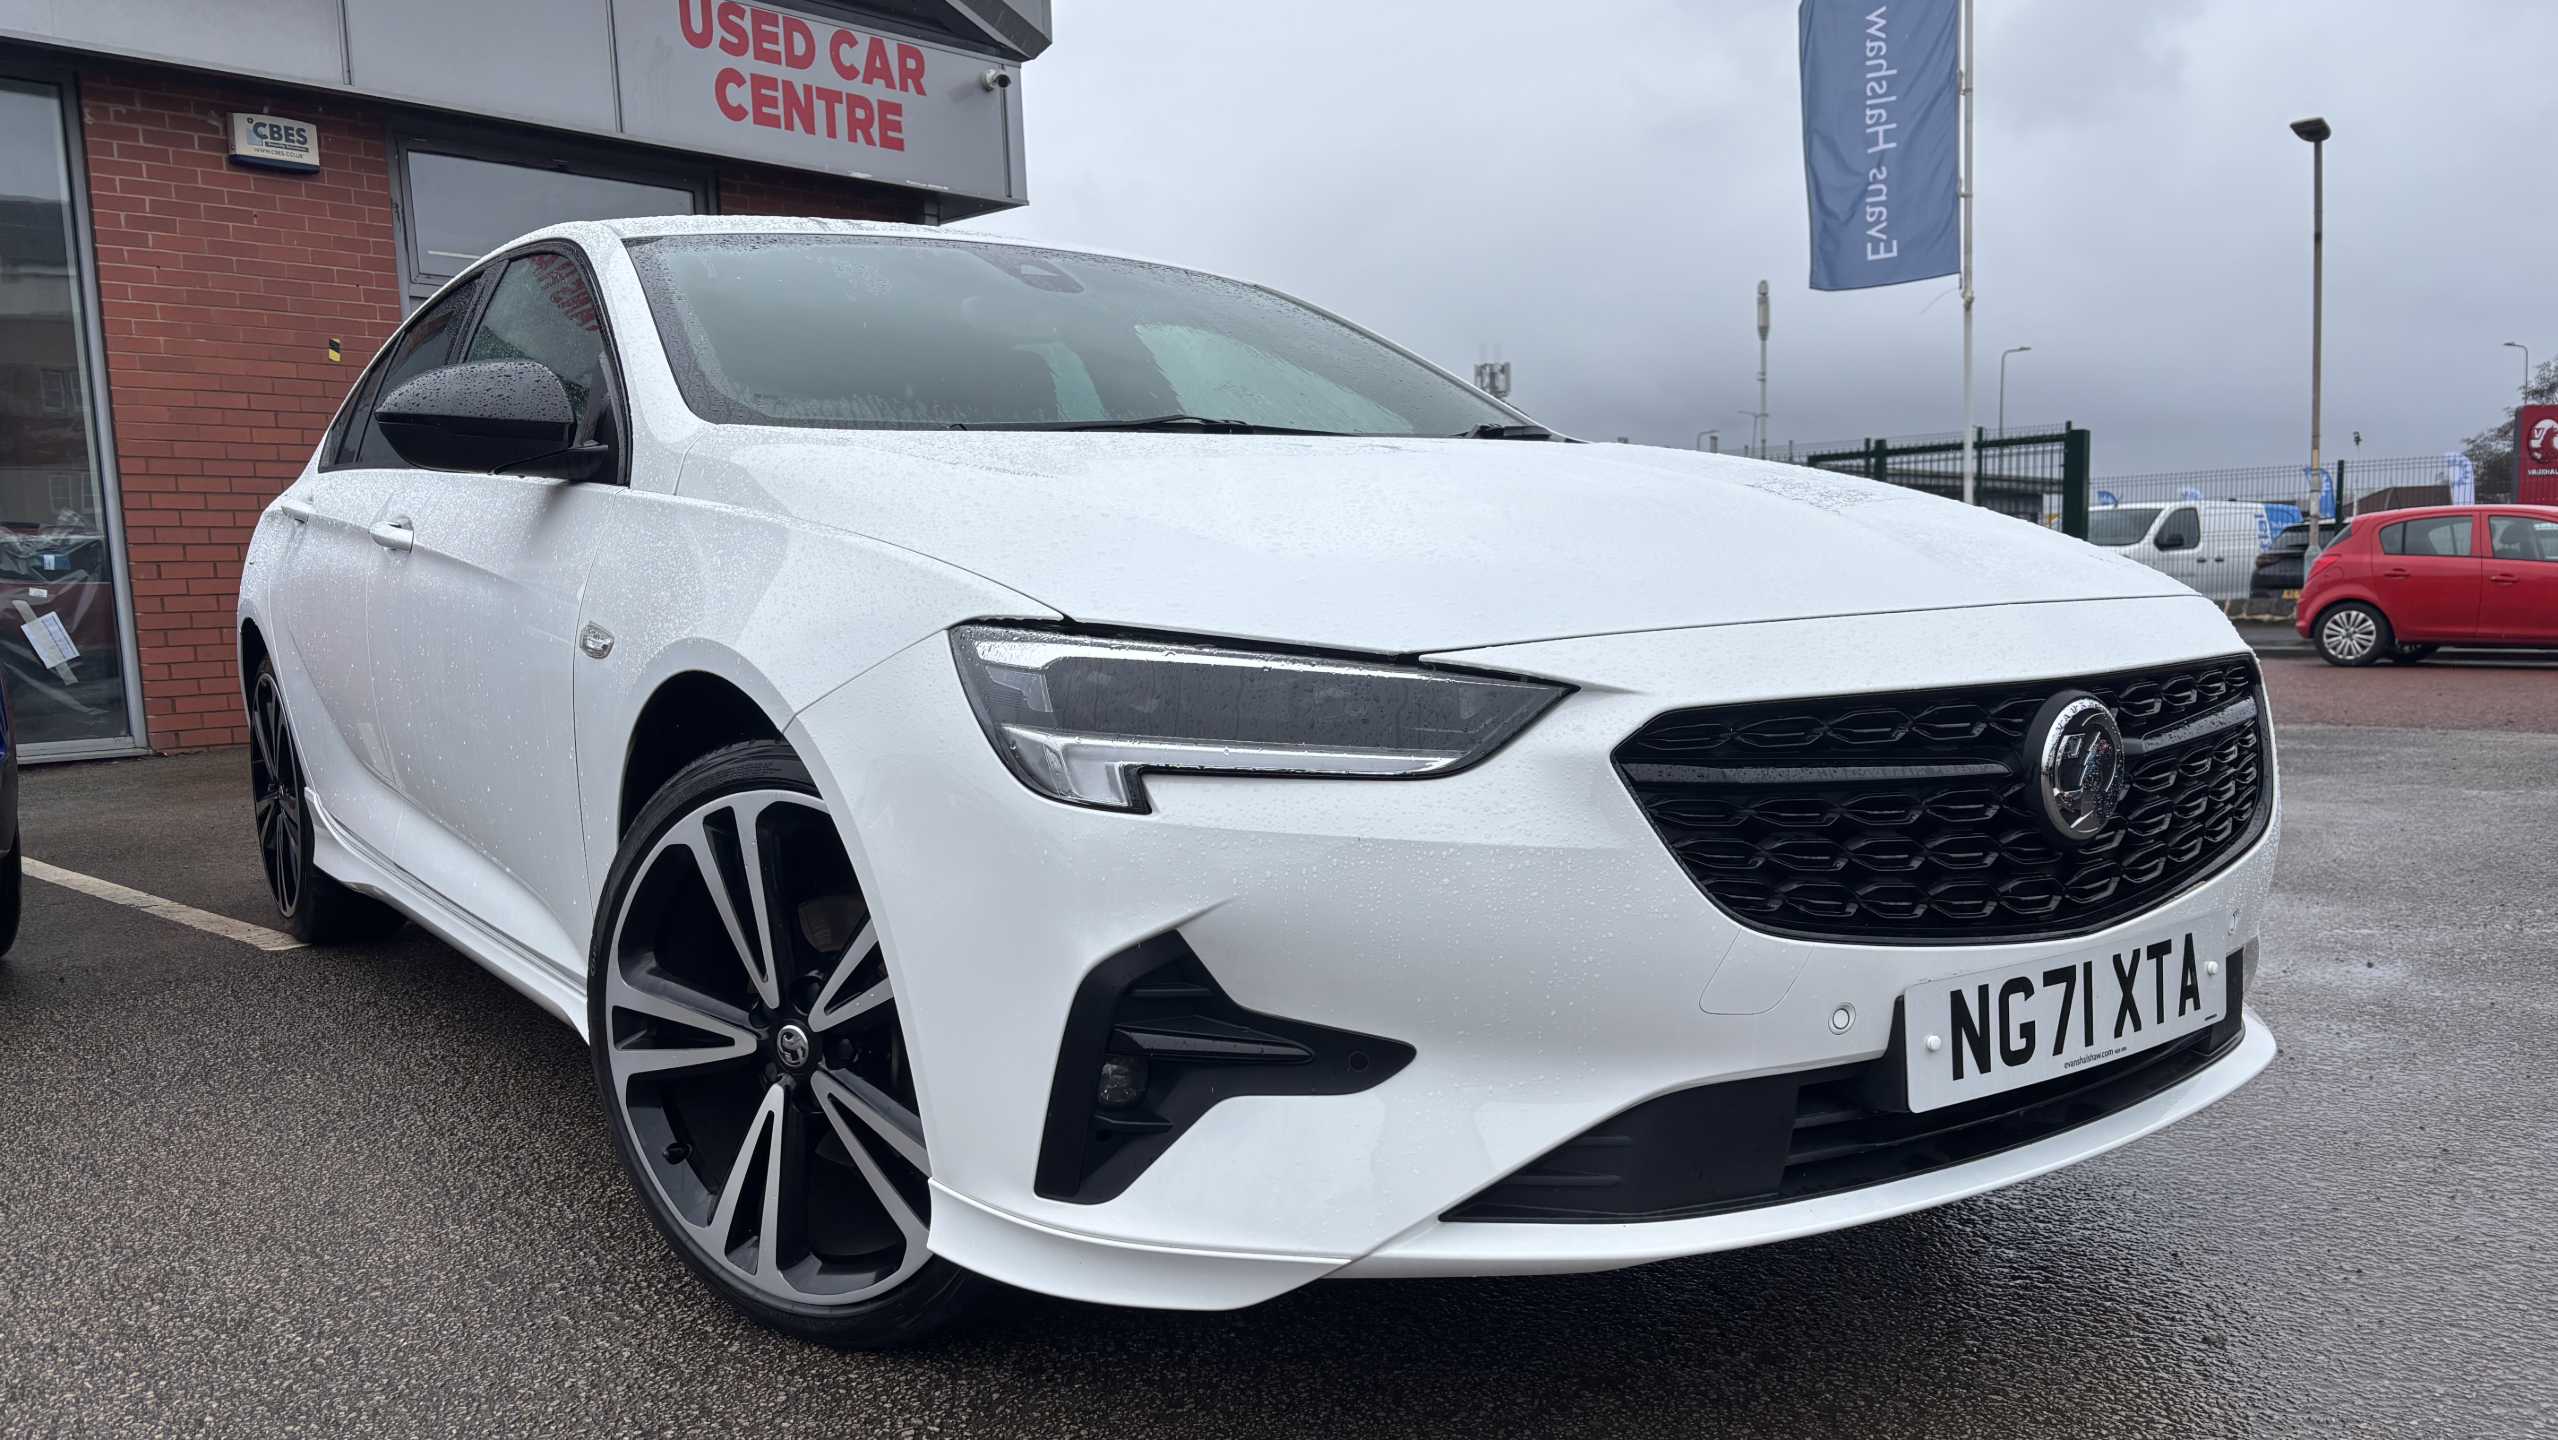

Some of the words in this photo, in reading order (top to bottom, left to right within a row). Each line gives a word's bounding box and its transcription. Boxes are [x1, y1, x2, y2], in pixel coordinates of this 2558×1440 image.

[679, 0, 816, 70] USED
[829, 28, 927, 97] CAR
[253, 122, 308, 146] CBES
[714, 67, 905, 152] CENTRE
[2528, 468, 2558, 476] VAUXHAL
[1950, 961, 2094, 1081] NG71
[2113, 933, 2201, 1039] XTA
